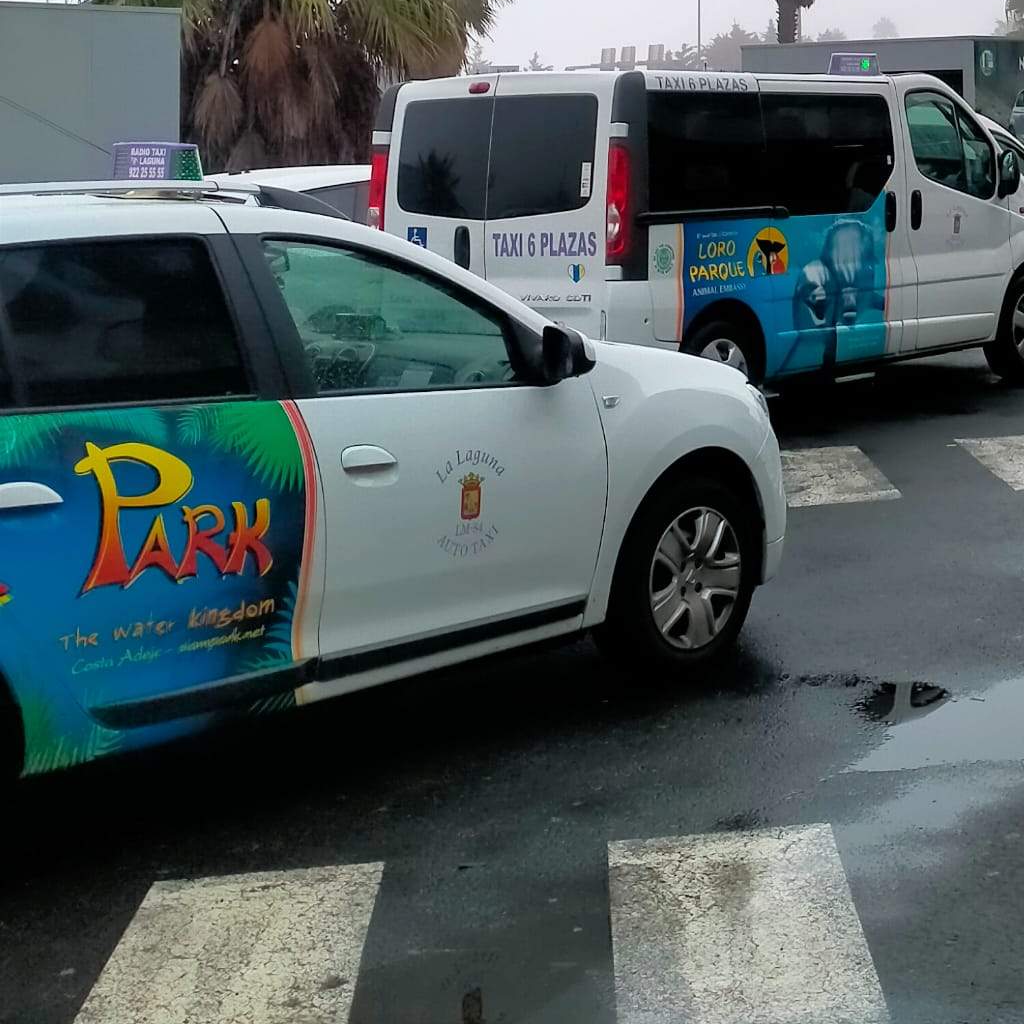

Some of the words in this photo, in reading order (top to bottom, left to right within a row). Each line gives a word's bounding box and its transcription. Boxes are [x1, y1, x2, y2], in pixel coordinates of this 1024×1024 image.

[655, 76, 685, 89] TAXI
[688, 77, 696, 89] 6
[699, 77, 748, 91] PLAZAS
[130, 147, 150, 156] RADIO
[151, 148, 167, 157] TAXI
[492, 233, 523, 257] TAXI
[527, 232, 536, 257] 6
[540, 232, 597, 257] PLAZAS
[698, 239, 736, 260] LORO
[689, 261, 745, 283] PARQUE
[436, 460, 454, 484] La
[456, 449, 505, 477] Laguna
[74, 441, 273, 597] PARK
[437, 535, 468, 556] AUTO
[471, 525, 499, 554] TAXI
[59, 626, 99, 651] The
[112, 618, 176, 641] water
[187, 598, 275, 628] kingdom
